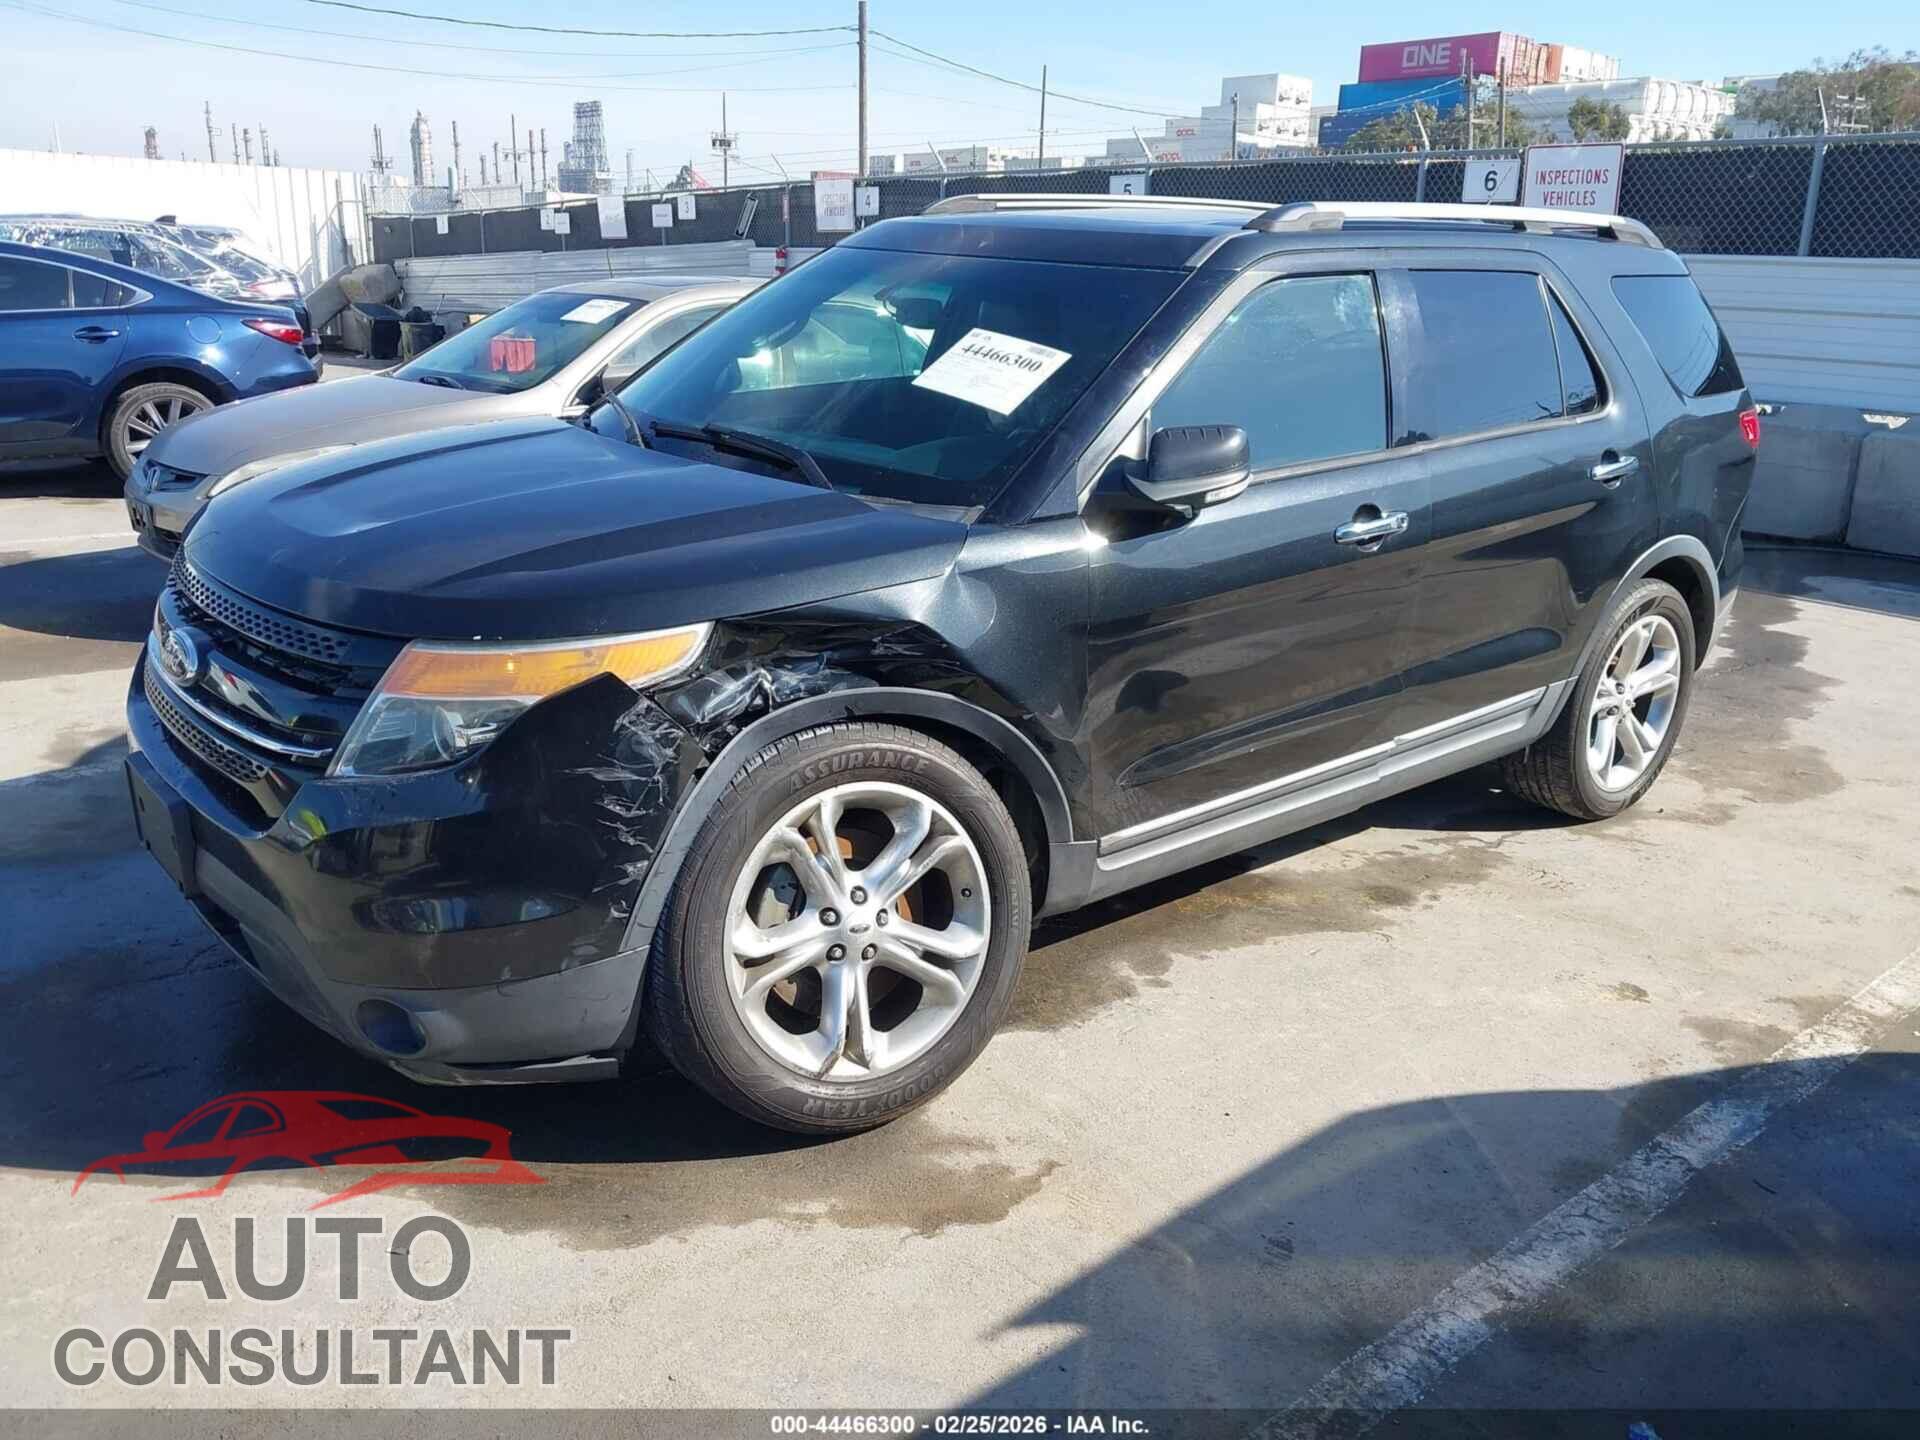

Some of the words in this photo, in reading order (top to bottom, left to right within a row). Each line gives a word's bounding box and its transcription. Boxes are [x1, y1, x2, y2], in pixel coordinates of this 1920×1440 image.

[1402, 43, 1452, 68] ONE
[1484, 170, 1498, 192] 6
[1535, 168, 1609, 185] INSPECTIONS
[1543, 190, 1597, 206] VEHICLES
[962, 343, 1043, 373] 44466300
[788, 750, 930, 793] ASSURANCE
